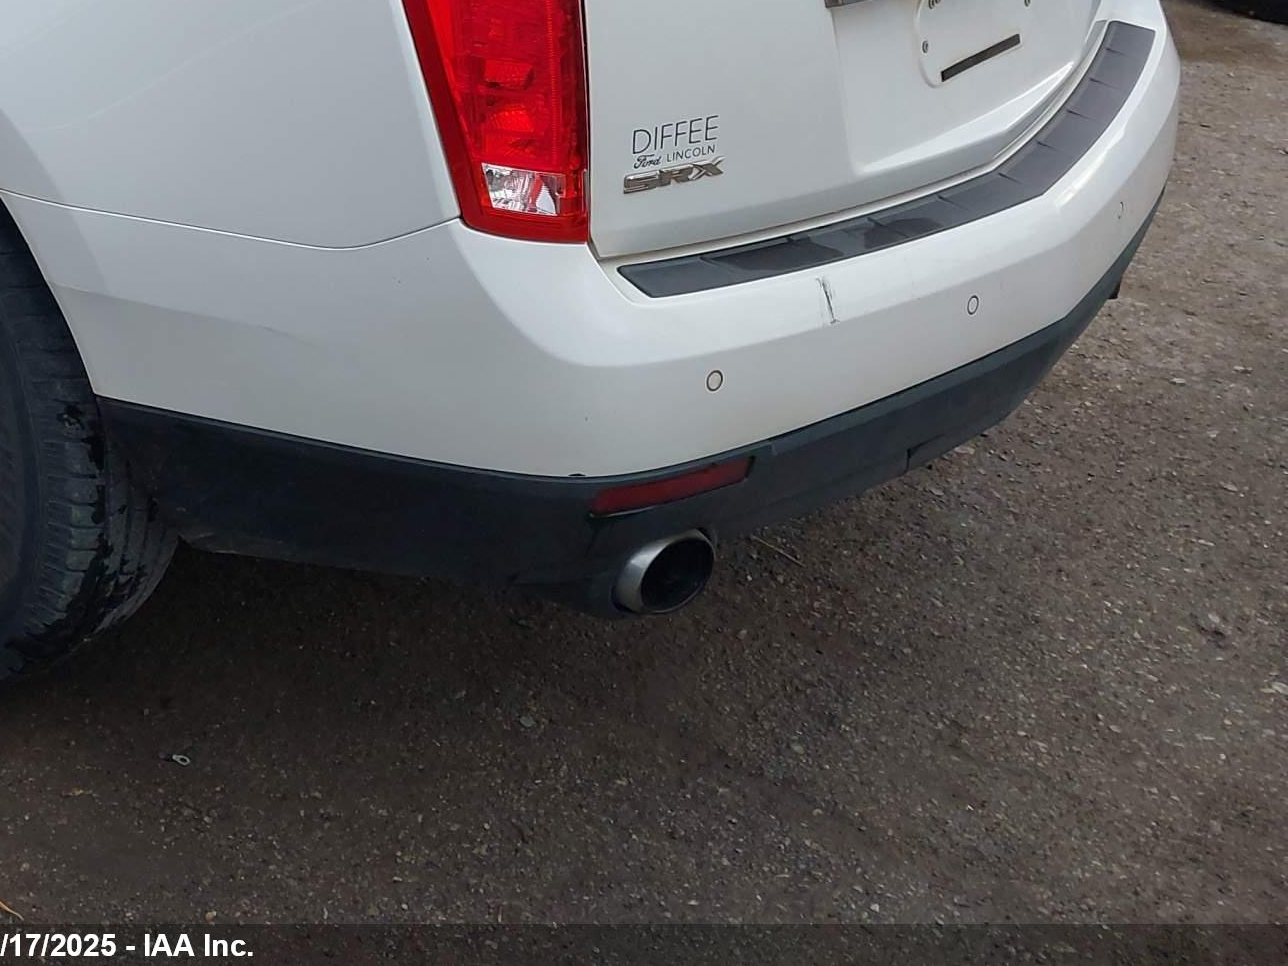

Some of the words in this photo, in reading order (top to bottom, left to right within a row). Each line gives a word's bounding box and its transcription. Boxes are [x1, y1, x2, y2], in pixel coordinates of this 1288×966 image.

[632, 114, 719, 155] DIFFEE
[622, 156, 728, 195] SRX
[633, 153, 662, 170] Ford
[666, 144, 716, 163] LINCOLN
